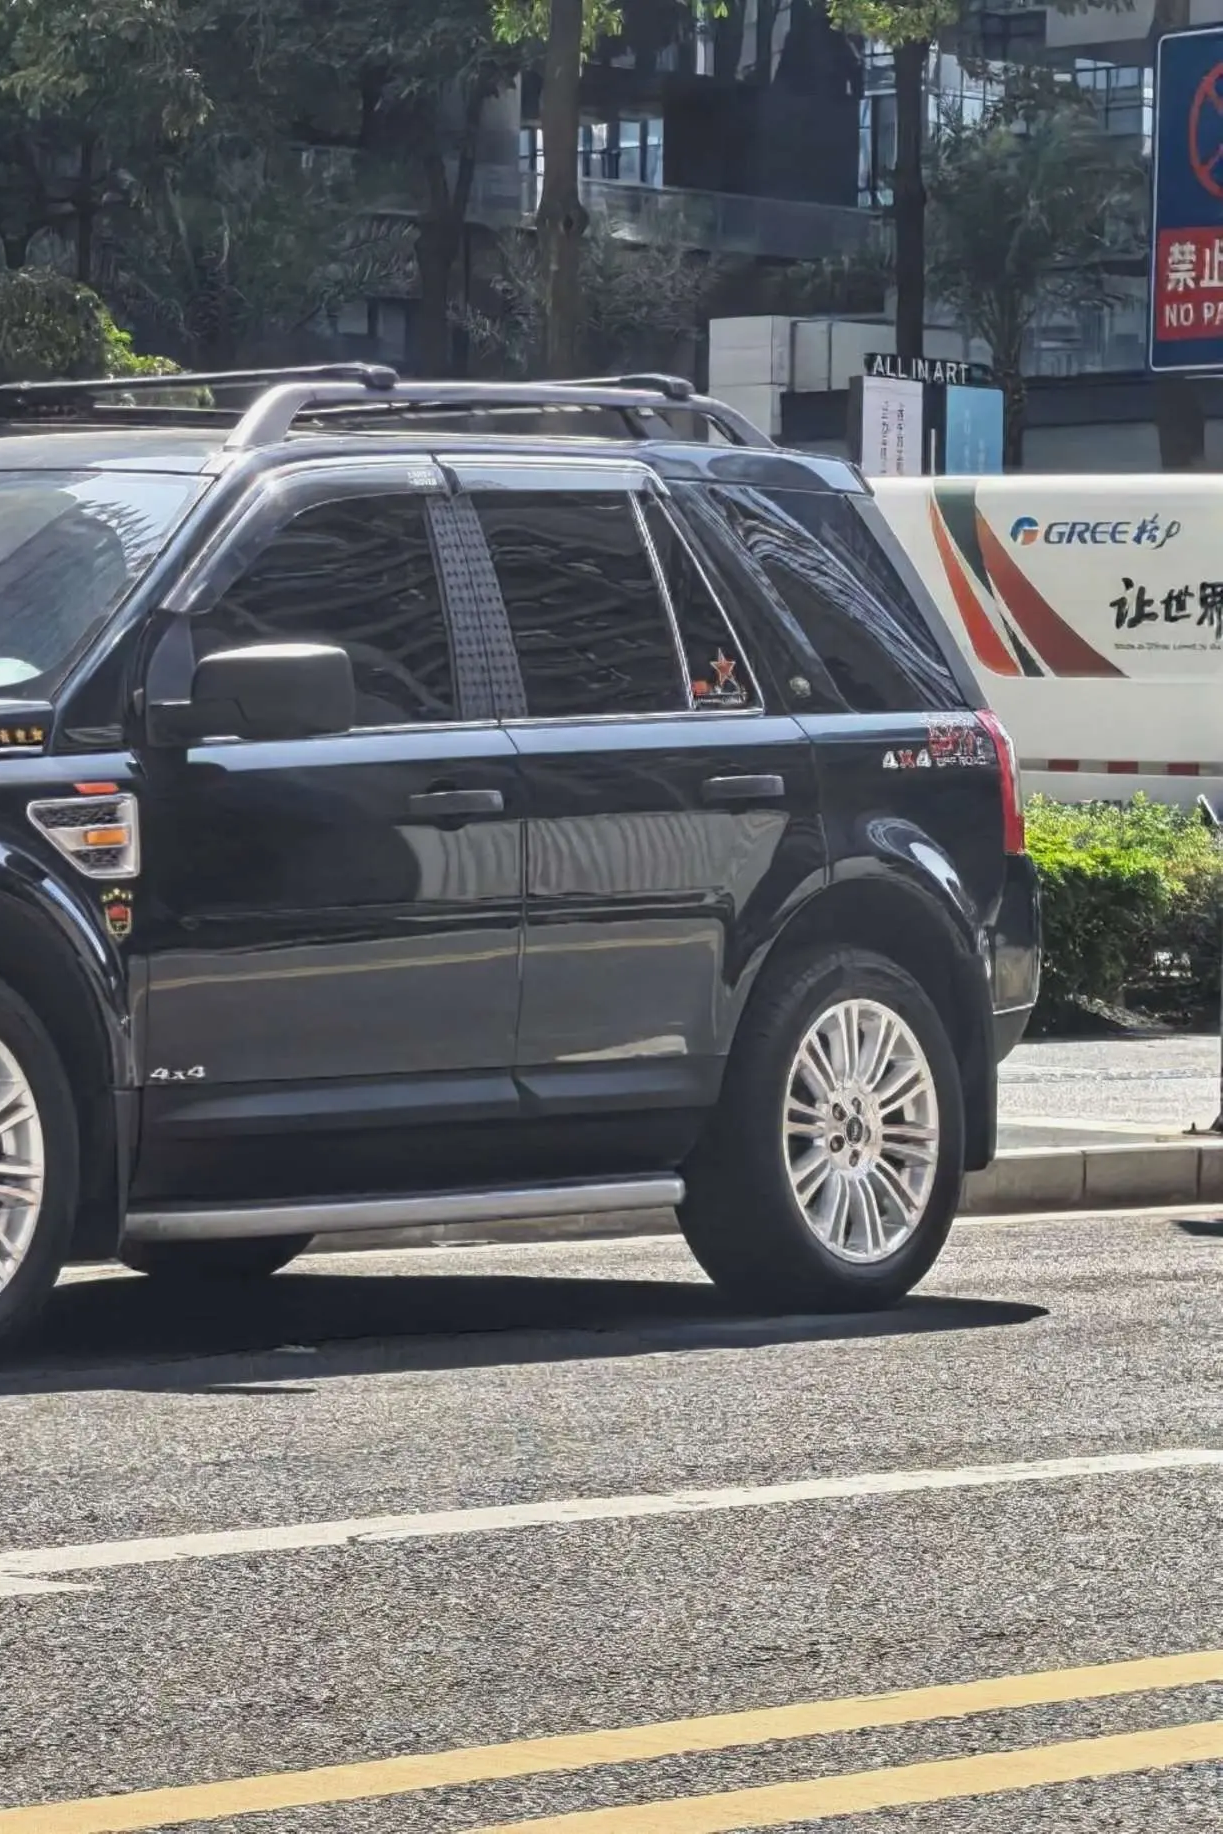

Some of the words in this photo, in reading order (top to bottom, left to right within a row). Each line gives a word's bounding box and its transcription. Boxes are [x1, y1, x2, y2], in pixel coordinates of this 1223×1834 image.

[1167, 239, 1223, 292] 禁止
[1165, 302, 1194, 328] NO
[873, 355, 907, 378] ALL
[912, 358, 928, 380] IN
[933, 361, 969, 384] ART
[1044, 521, 1131, 544] GREE
